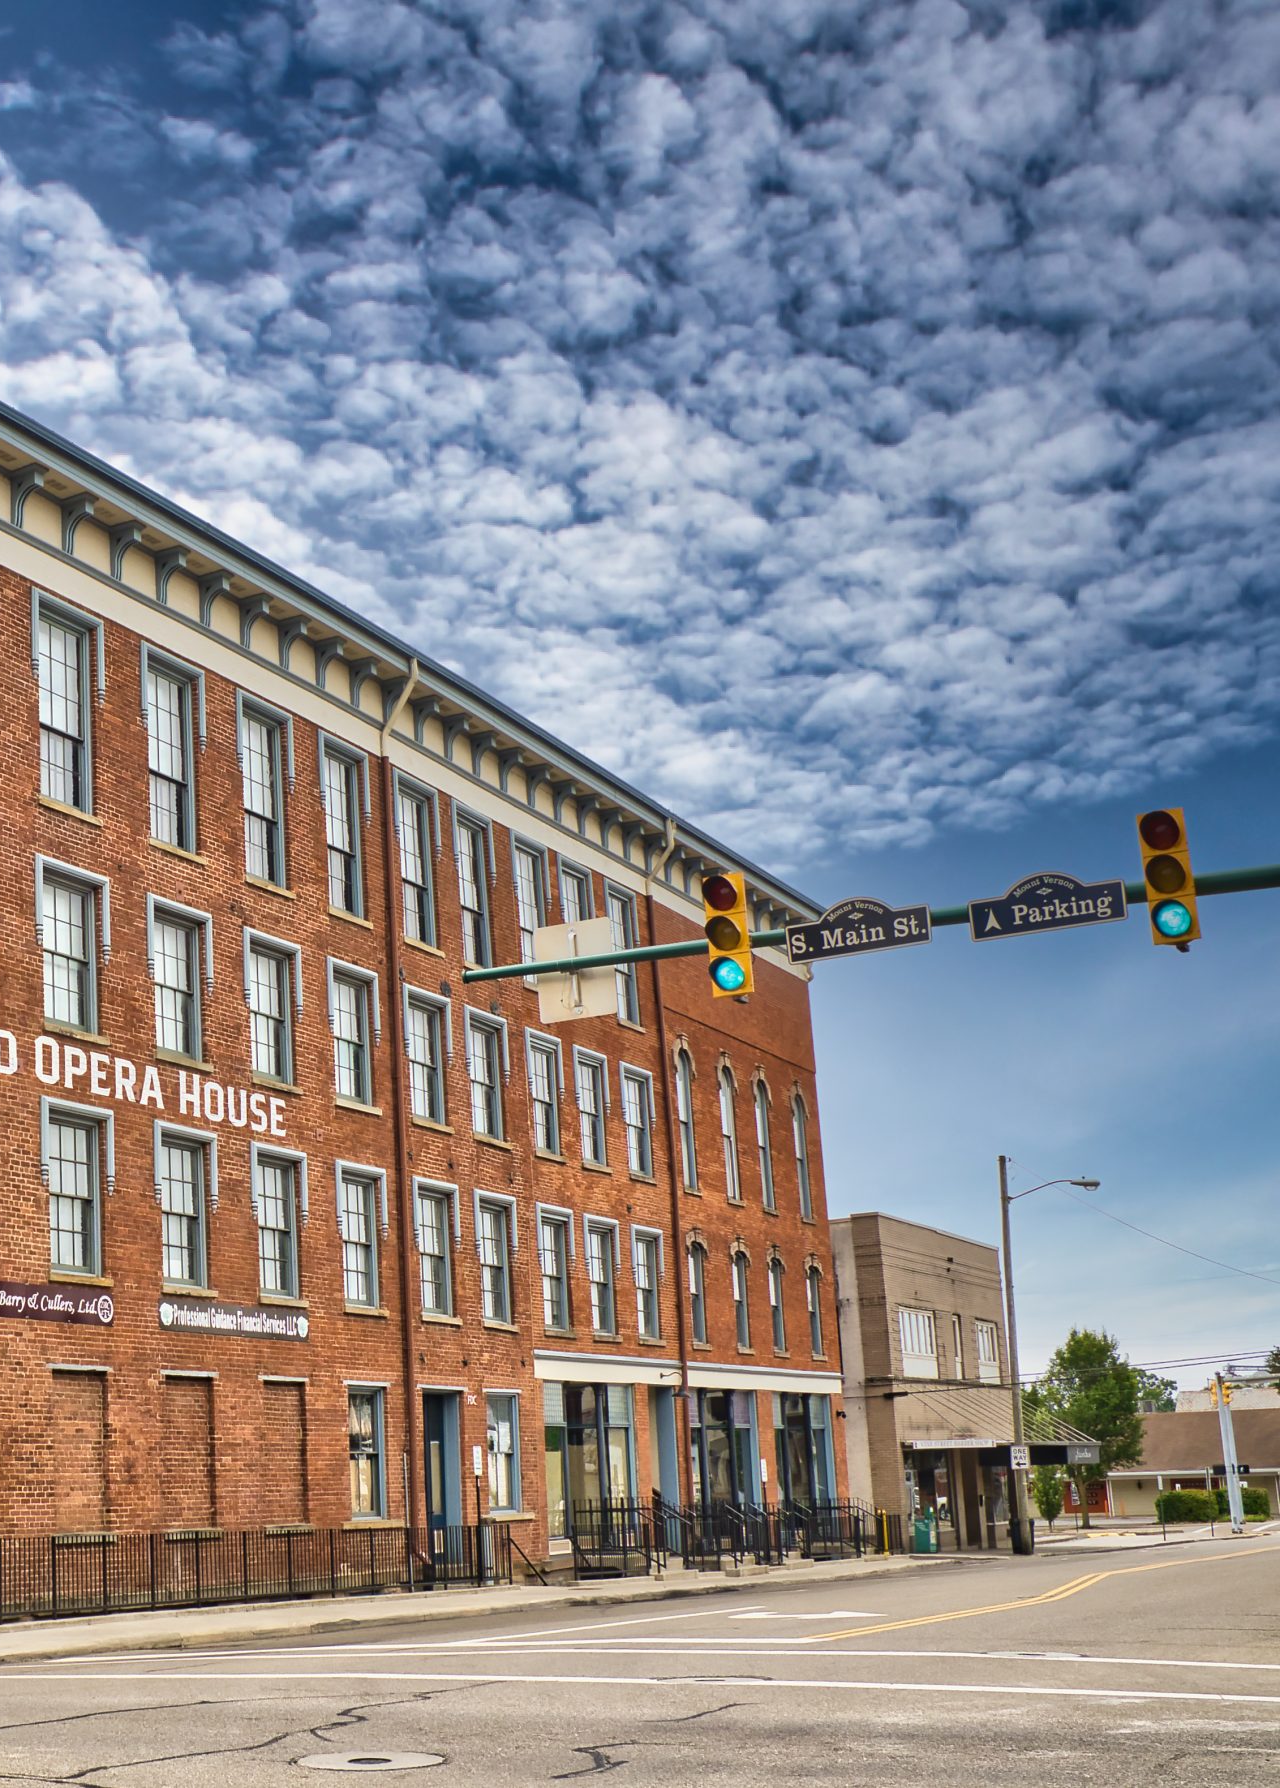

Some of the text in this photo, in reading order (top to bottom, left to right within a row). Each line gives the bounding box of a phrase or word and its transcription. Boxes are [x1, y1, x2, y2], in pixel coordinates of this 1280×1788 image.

[1012, 876, 1074, 898] Mount Vernon
[826, 901, 883, 922] Mount Vernon
[1011, 896, 1112, 925] Parking
[791, 915, 926, 954] S. Main St.
[34, 1036, 165, 1110] OPERA
[179, 1070, 287, 1137] HOUSE
[28, 1293, 38, 1310] &
[40, 1294, 75, 1315] Cullers,
[77, 1298, 98, 1314] Ltd.
[173, 1304, 297, 1336] Professional Guidance Financial Services LLC
